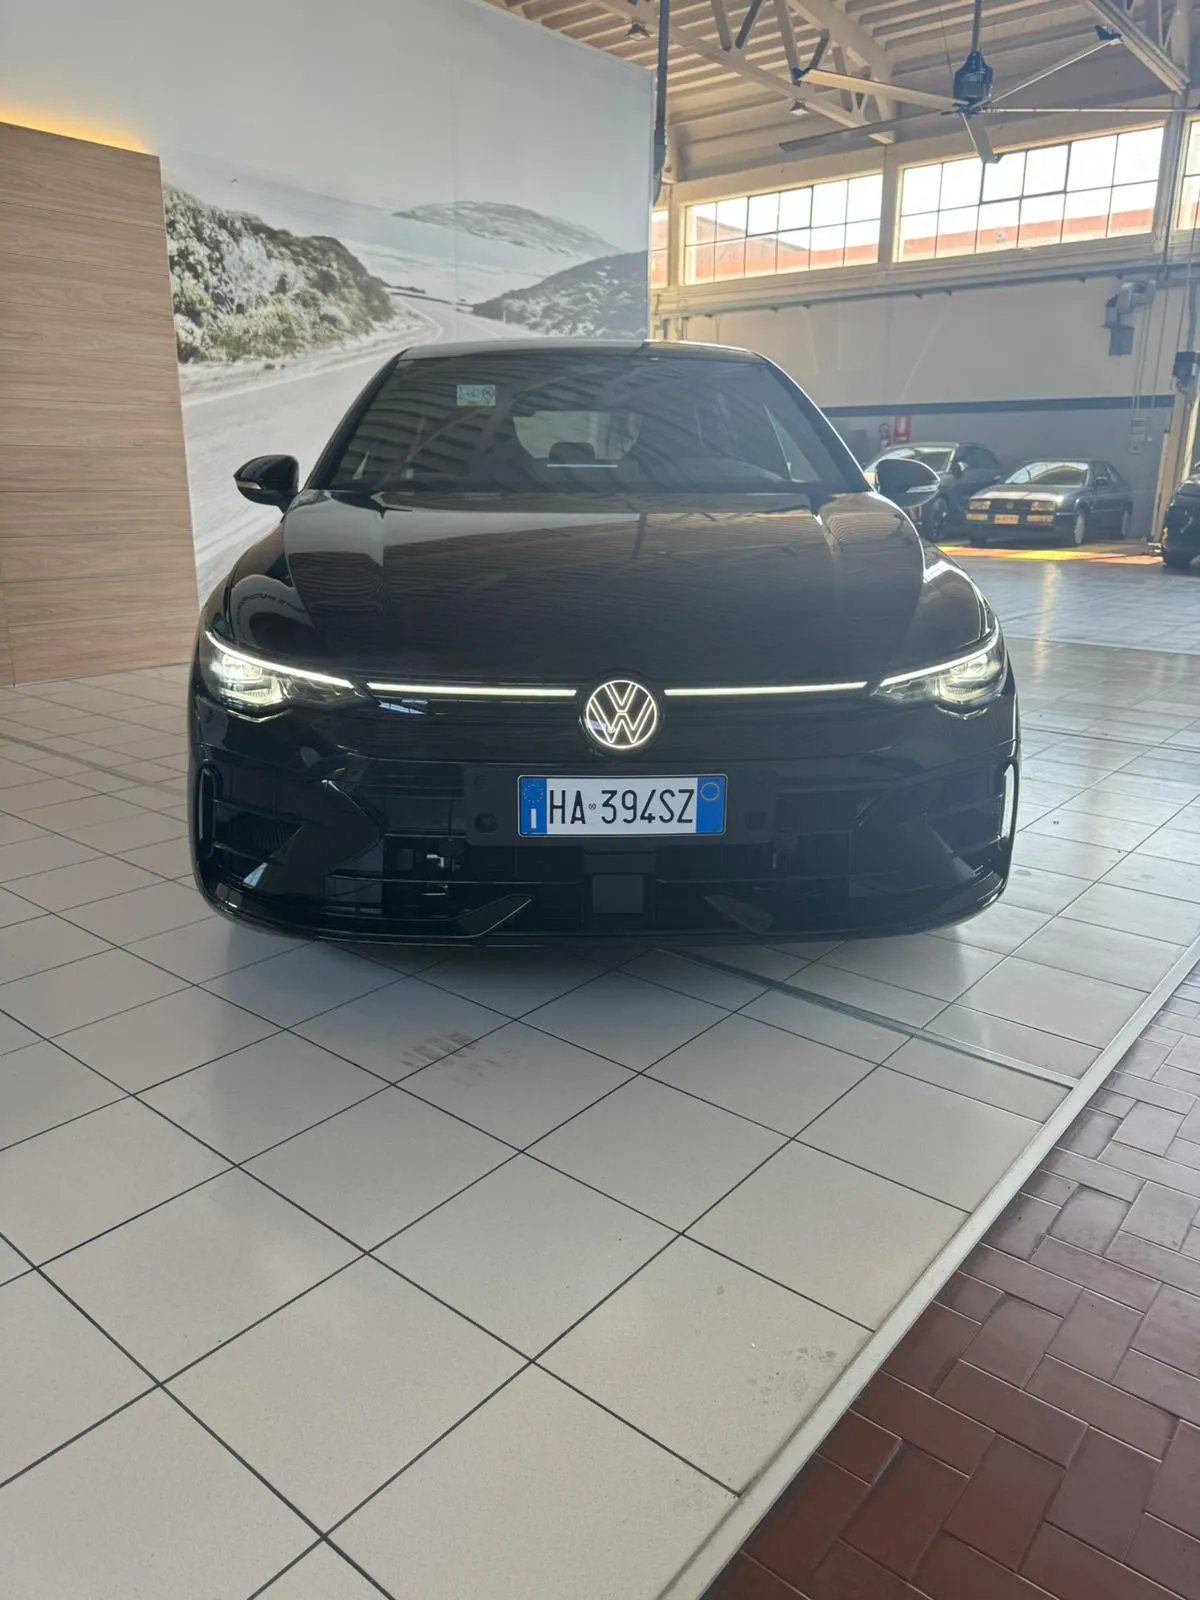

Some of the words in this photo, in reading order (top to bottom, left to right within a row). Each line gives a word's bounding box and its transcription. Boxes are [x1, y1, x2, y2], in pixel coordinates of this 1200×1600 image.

[588, 681, 656, 747] VW
[549, 789, 586, 824] HA
[601, 788, 695, 824] 394SZ
